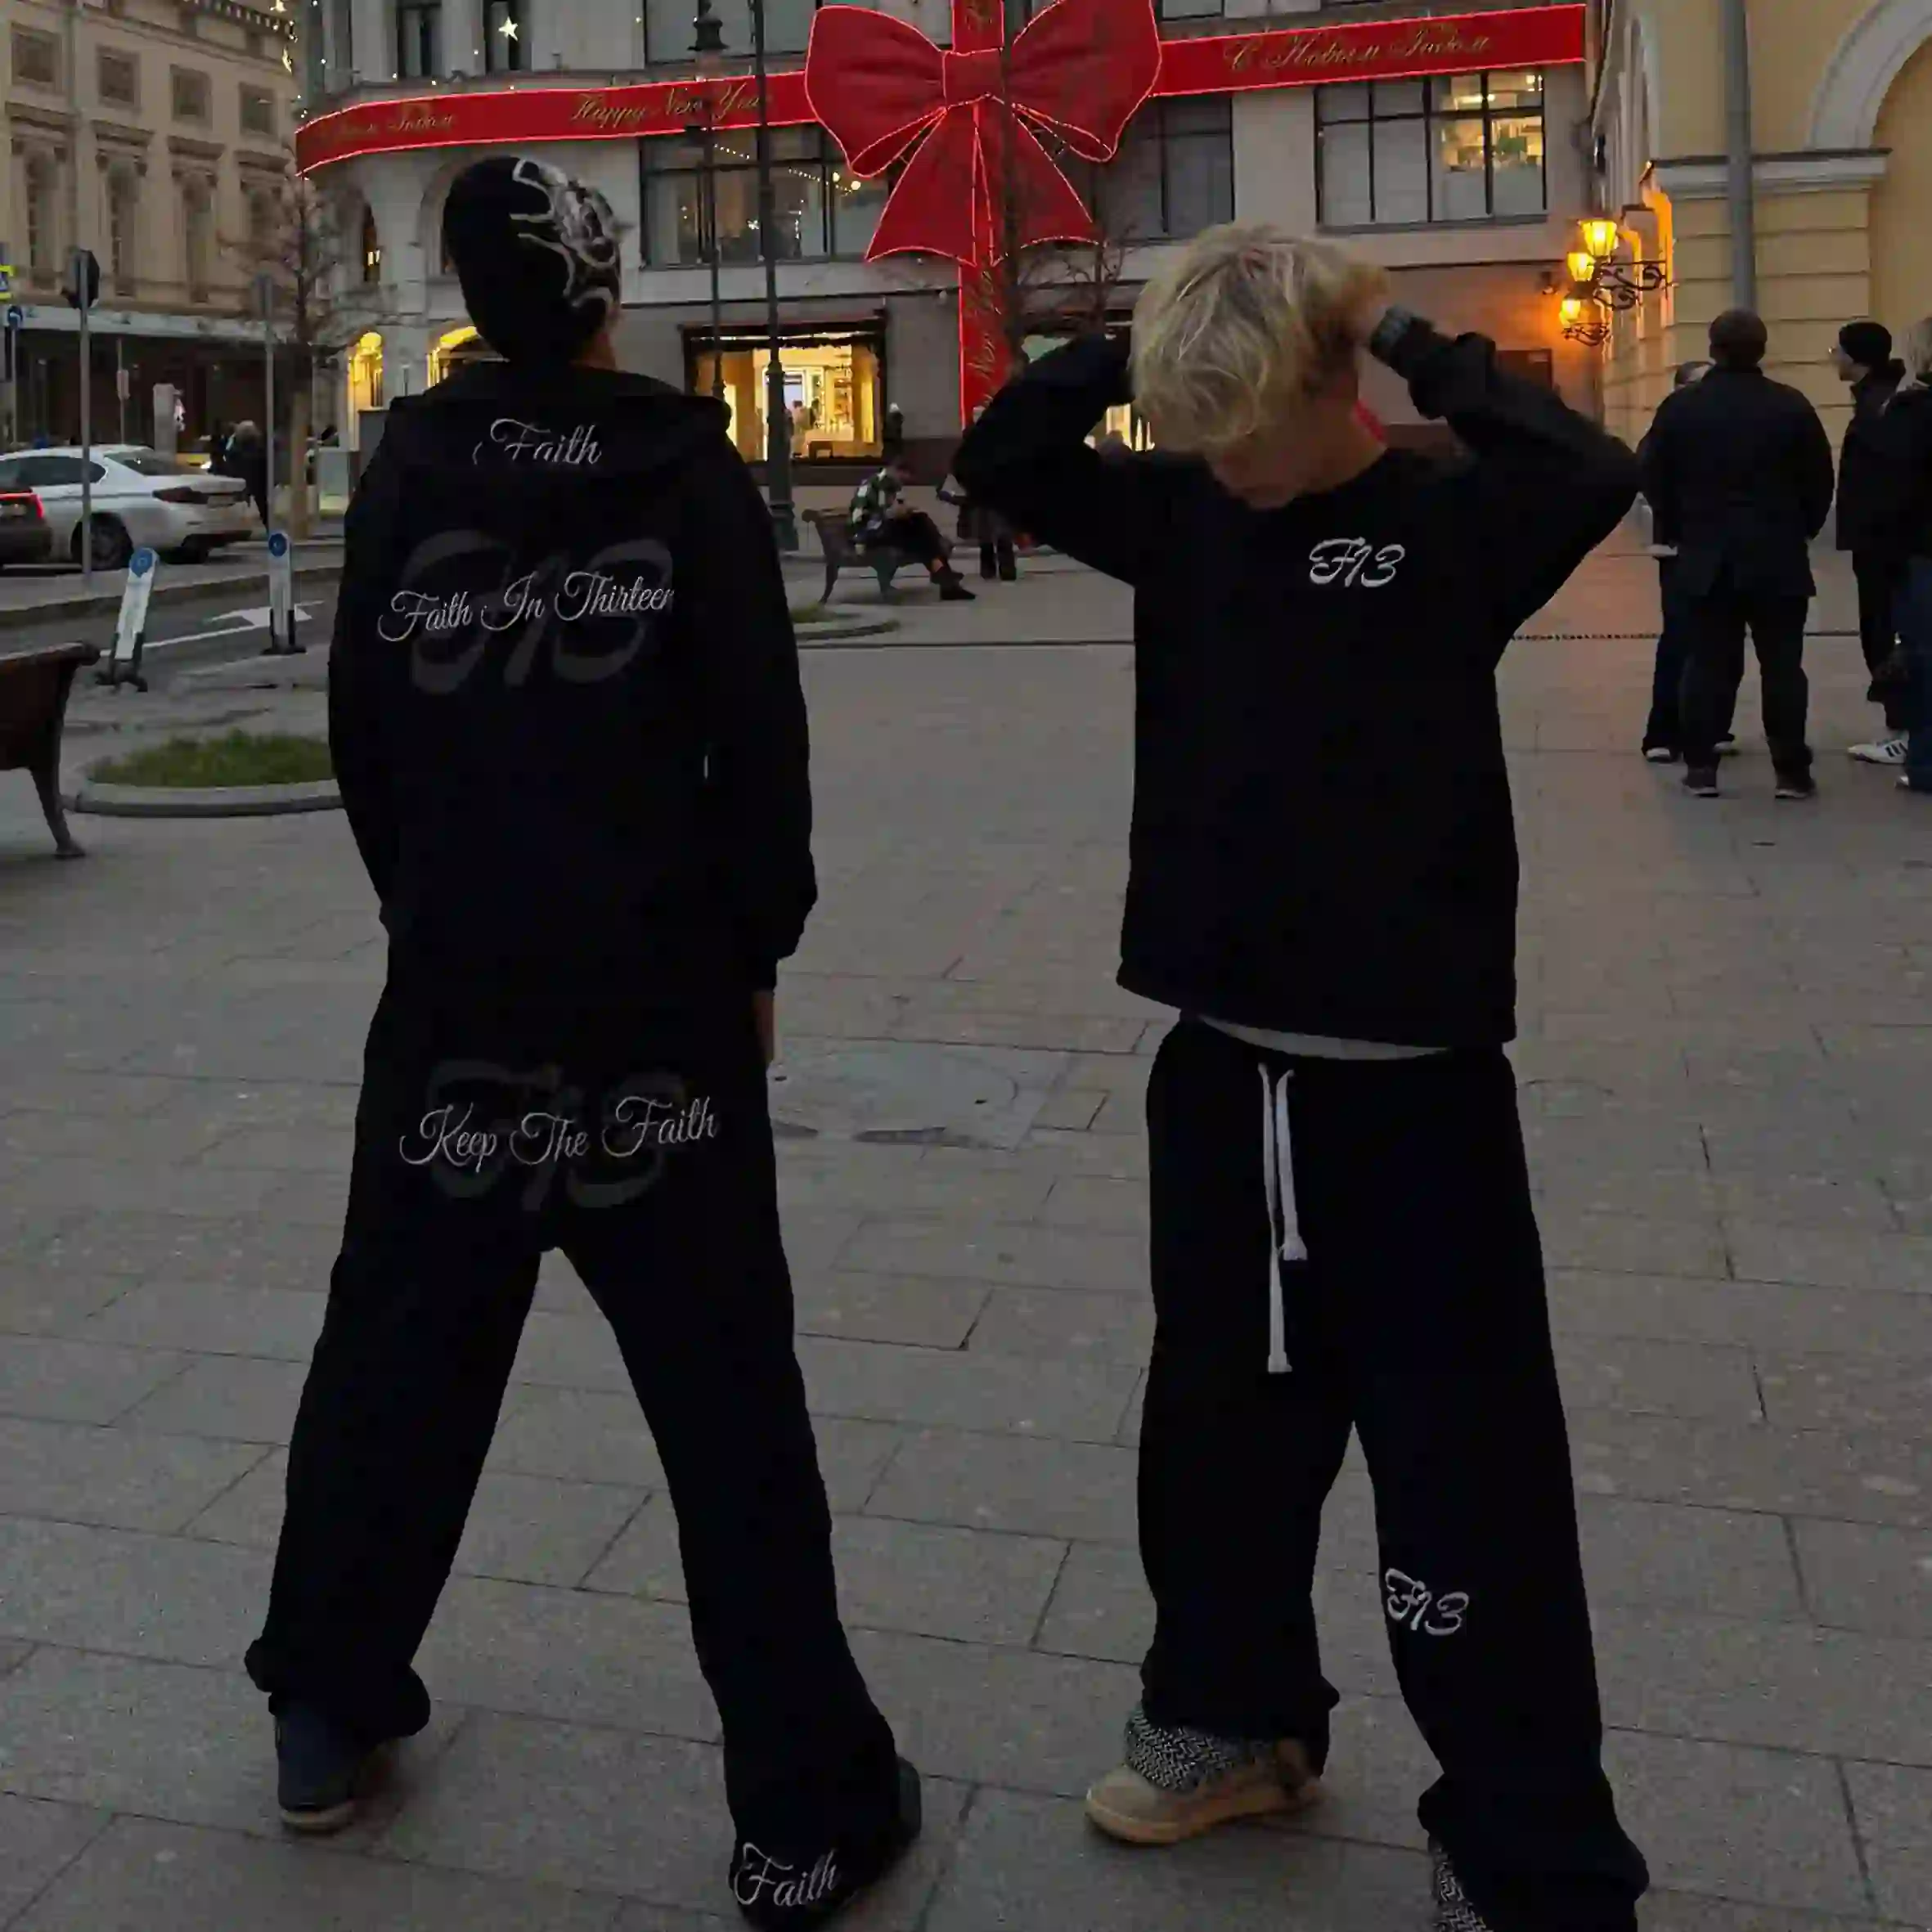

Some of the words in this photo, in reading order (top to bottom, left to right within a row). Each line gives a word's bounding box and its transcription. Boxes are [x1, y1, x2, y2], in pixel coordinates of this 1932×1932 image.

[710, 82, 767, 121] Yea
[472, 418, 602, 465] Faith
[1309, 537, 1405, 588] F13
[377, 590, 474, 642] Faith
[480, 570, 546, 631] In
[399, 1102, 498, 1173] Keep
[509, 1112, 590, 1165] The
[602, 1096, 719, 1157] Faith
[1385, 1567, 1469, 1636] F13
[734, 1842, 840, 1907] Faith
